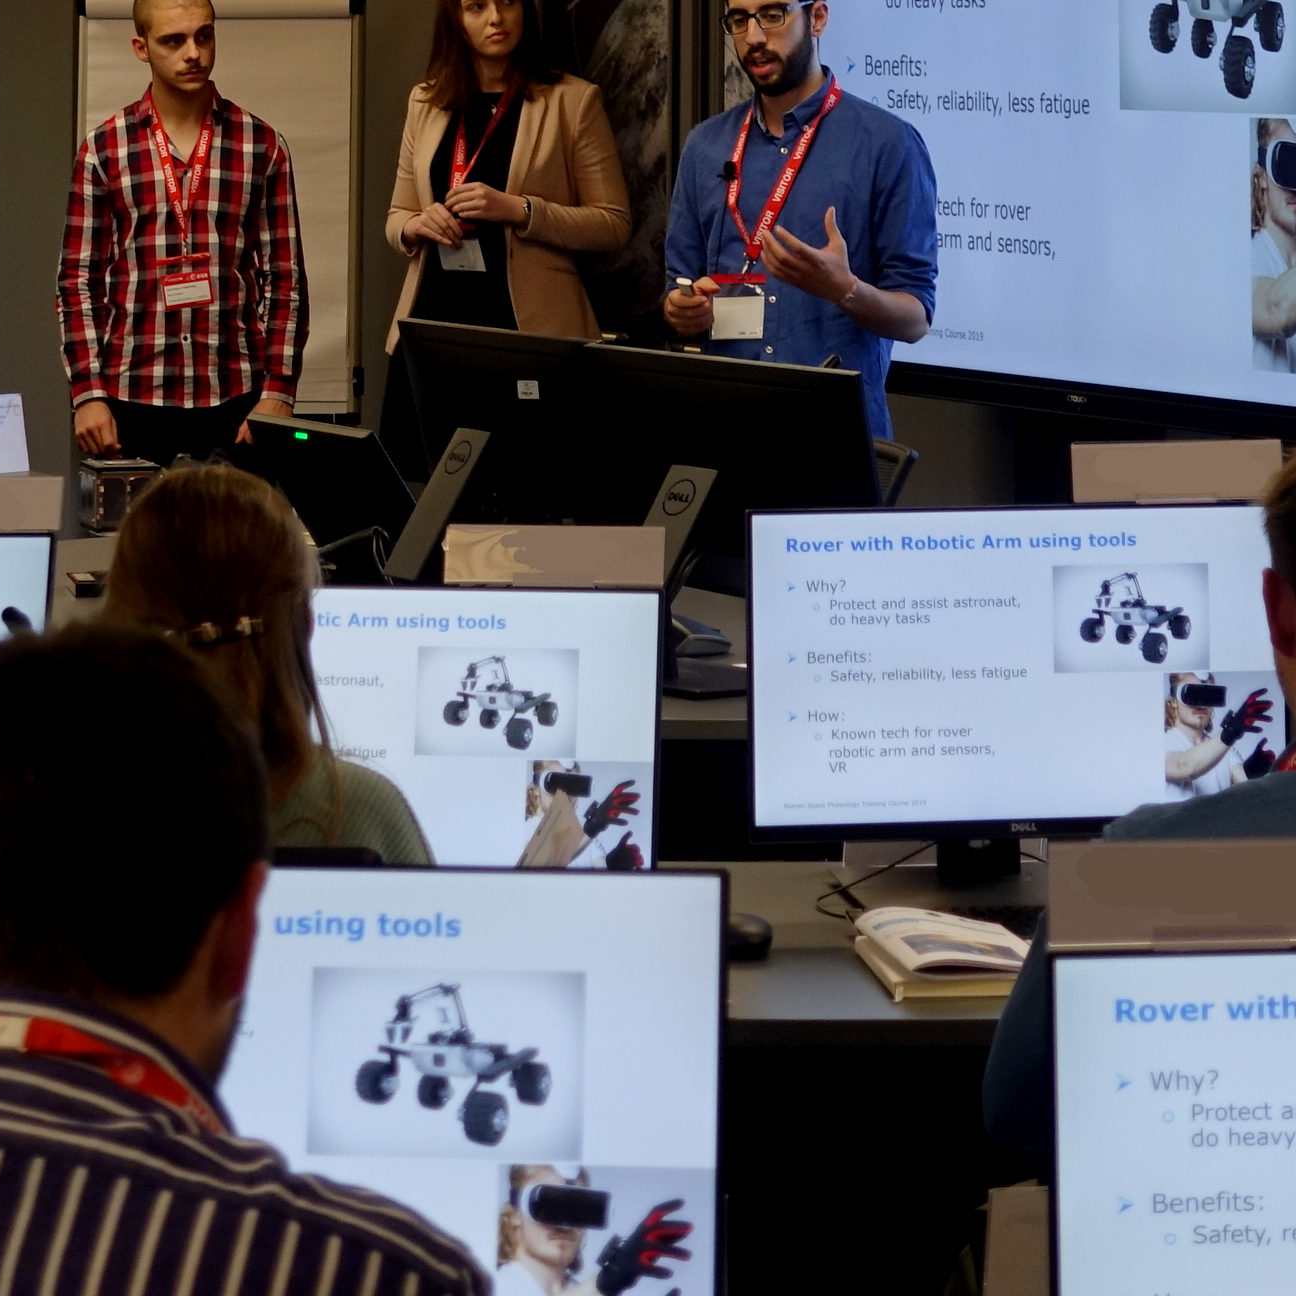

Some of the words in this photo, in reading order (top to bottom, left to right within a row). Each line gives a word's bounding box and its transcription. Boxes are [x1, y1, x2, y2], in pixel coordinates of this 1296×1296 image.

[864, 54, 926, 77] Benefits:
[887, 88, 931, 114] Safety,
[937, 89, 1002, 117] reliability,
[1008, 91, 1034, 113] less
[1039, 92, 1090, 119] fatigue
[155, 129, 168, 158] VISITOR
[198, 130, 209, 157] VISITOR
[164, 163, 177, 194] VISITOR
[191, 164, 202, 194] VISITOR
[772, 167, 795, 202] VISITOR
[937, 196, 965, 217] tech
[970, 197, 990, 218] for
[994, 203, 1031, 221] rover
[937, 232, 962, 249] arm
[967, 231, 992, 252] and
[997, 236, 1055, 260] sensors,
[668, 492, 694, 504] DELL
[786, 538, 843, 553] Rover
[850, 535, 893, 551] with
[901, 534, 975, 550] Robotic
[981, 534, 1021, 549] Arm
[1029, 533, 1081, 551] using
[1088, 531, 1136, 547] tools
[805, 579, 846, 595] Why?
[829, 598, 877, 610] Protect
[881, 597, 905, 610] and
[910, 597, 948, 609] assist
[953, 595, 1020, 608] astronaut,
[347, 612, 388, 627] Arm
[396, 613, 450, 632] using
[456, 614, 506, 630] tools
[829, 613, 845, 626] do
[851, 613, 890, 627] heavy
[895, 611, 930, 624] tasks
[807, 650, 871, 664] Benefits:
[830, 669, 876, 684] Safety,
[881, 667, 945, 682] reliability,
[951, 667, 976, 679] less
[981, 666, 1027, 680] fatigue
[807, 709, 844, 722] How:
[831, 728, 876, 740] Known
[880, 726, 909, 739] tech
[914, 726, 933, 738] for
[937, 727, 973, 737] rover
[829, 745, 875, 758] robotic
[879, 747, 906, 757] arm
[911, 743, 935, 756] and
[940, 745, 995, 756] sensors,
[828, 761, 847, 773] VR
[1011, 822, 1038, 832] DELL
[1115, 998, 1214, 1023] Rover
